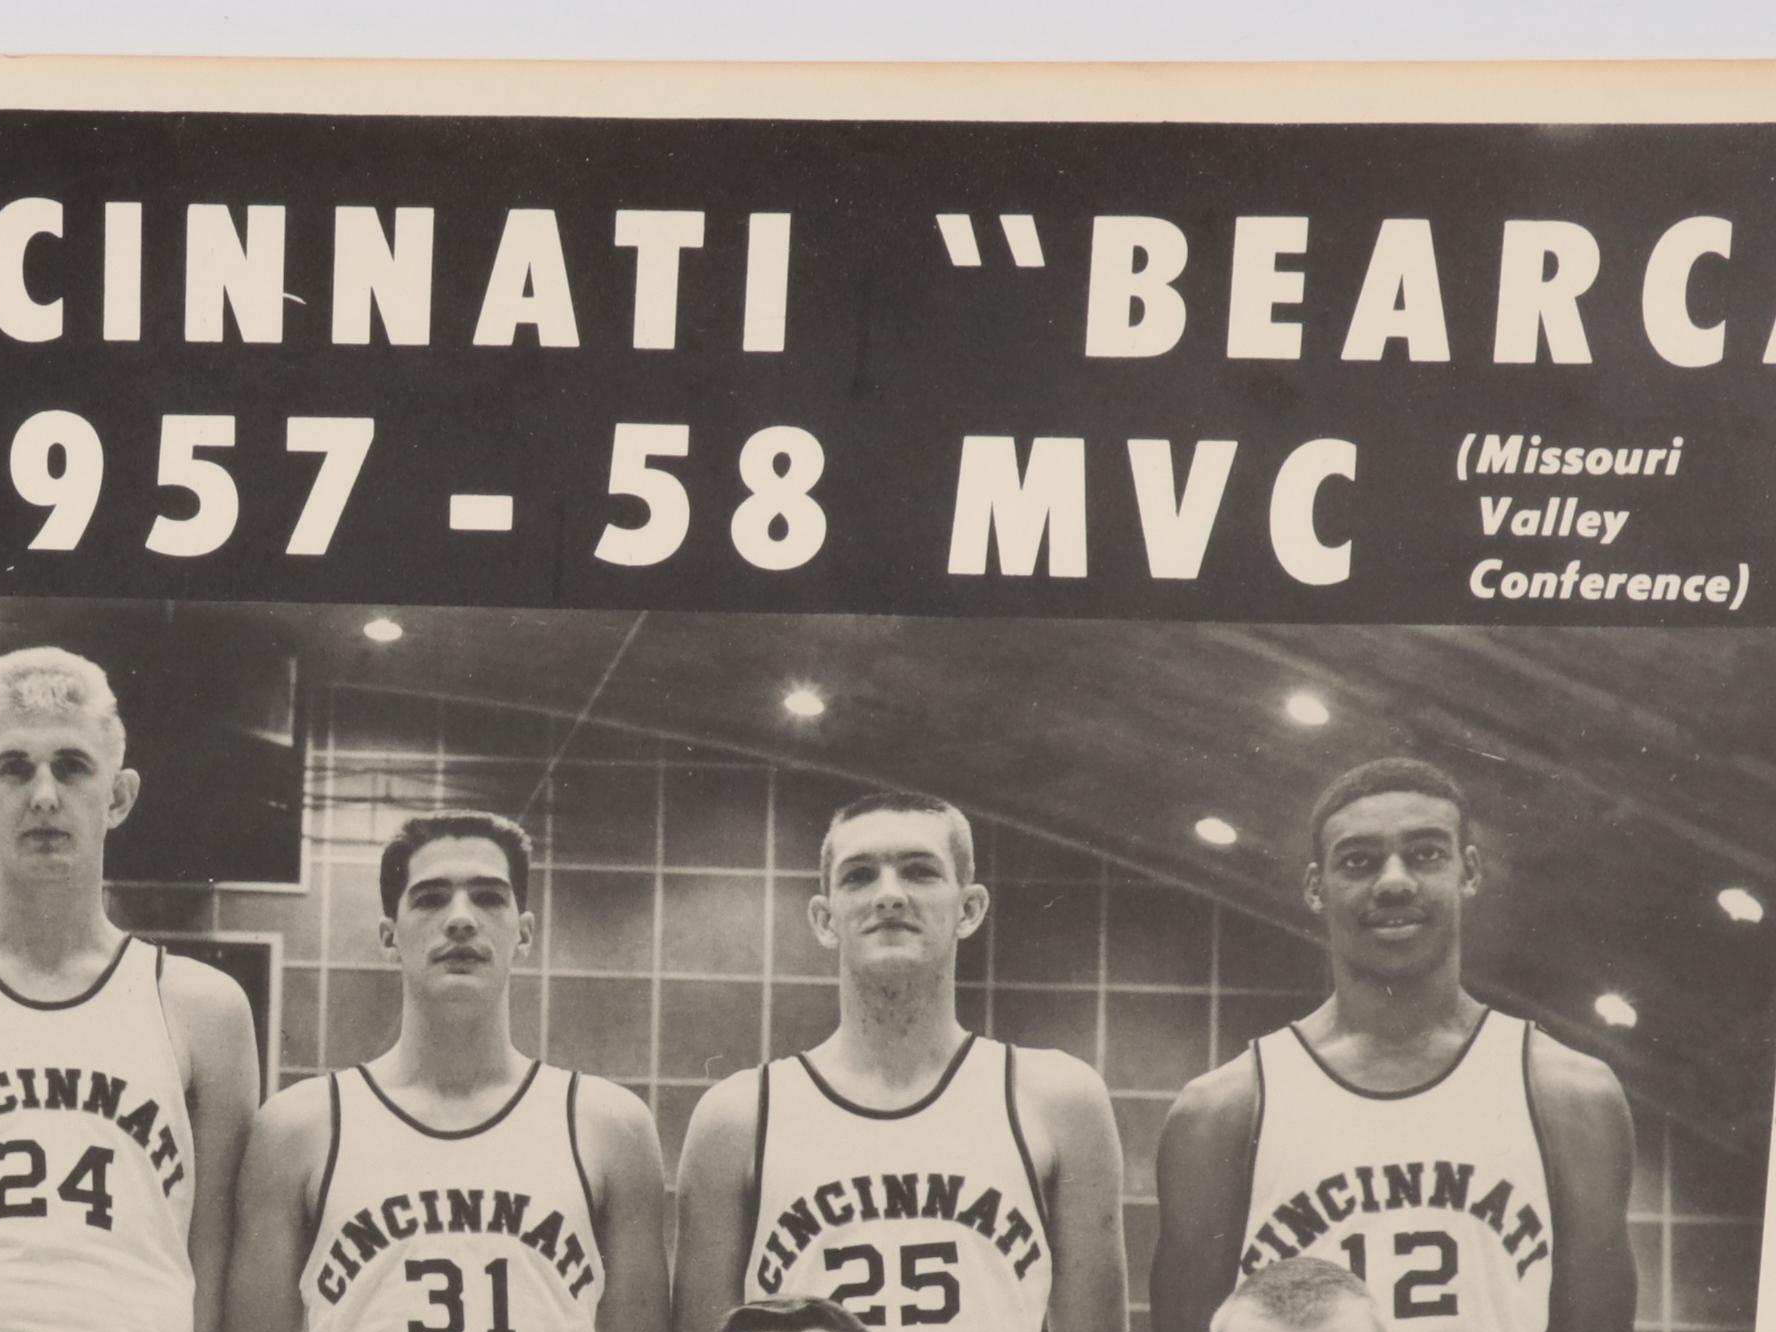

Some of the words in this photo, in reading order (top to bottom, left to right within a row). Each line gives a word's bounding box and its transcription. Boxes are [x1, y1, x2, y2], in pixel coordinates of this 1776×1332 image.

[1457, 434, 1683, 480] (Missouri
[948, 436, 1356, 585] MVC
[1481, 497, 1629, 544] Valley
[1470, 559, 1749, 610] Conference)
[317, 1188, 595, 1305] CINCINNATI
[756, 1173, 1041, 1295] CINCINNATI
[1241, 1161, 1548, 1281] CINCINNATI
[825, 1241, 960, 1327] 25
